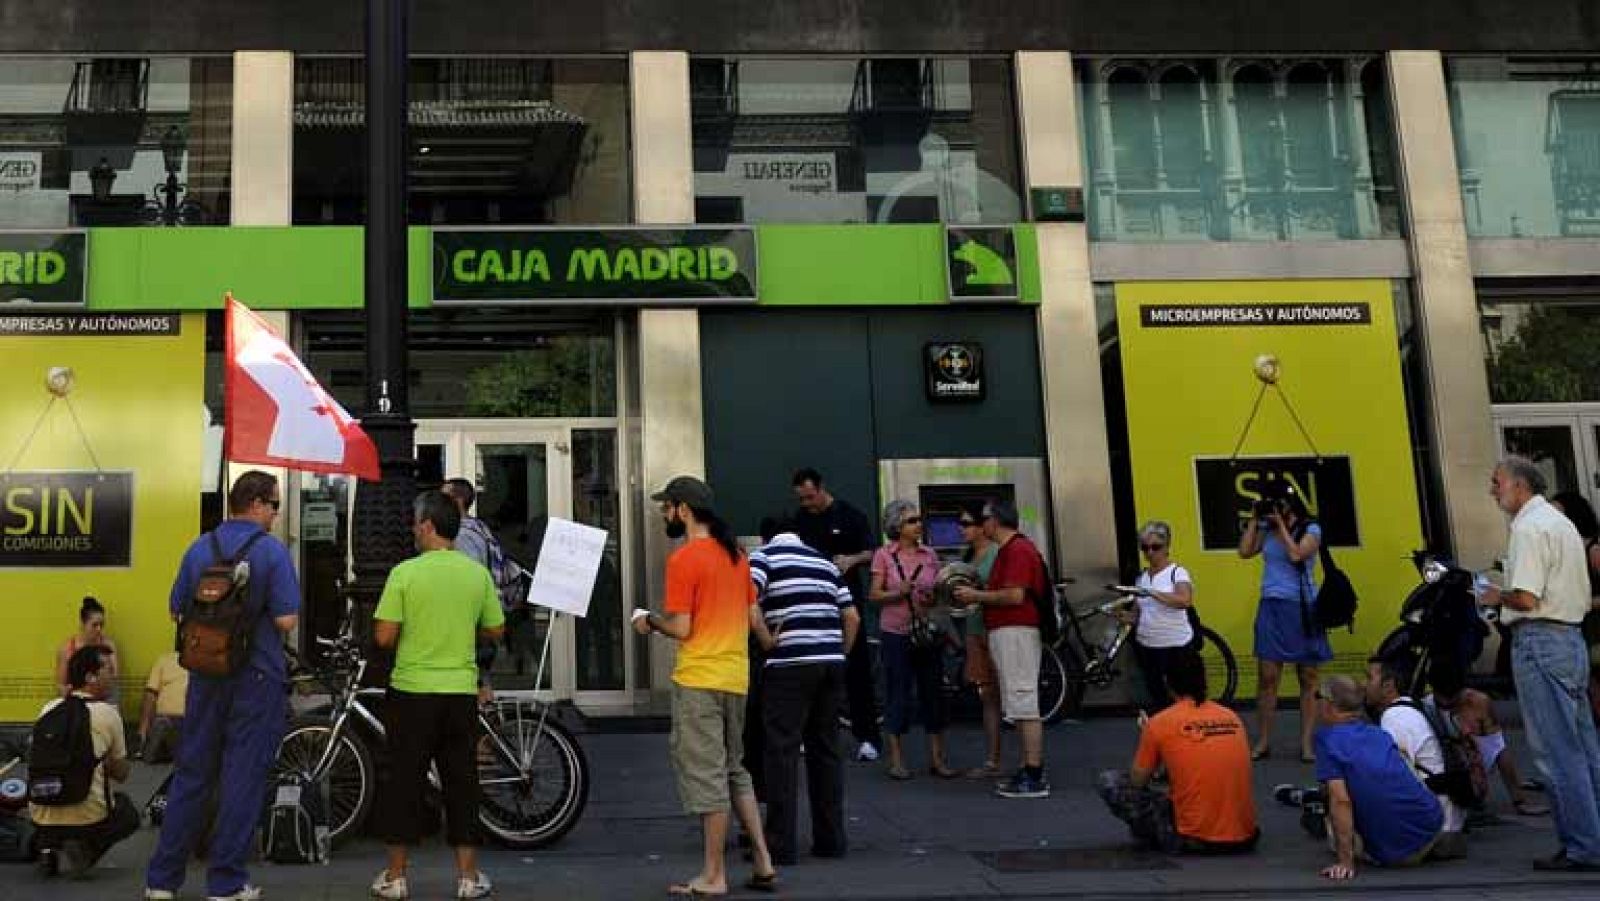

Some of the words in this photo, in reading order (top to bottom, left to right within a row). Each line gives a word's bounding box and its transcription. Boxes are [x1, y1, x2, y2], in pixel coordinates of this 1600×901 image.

[453, 249, 551, 281] CAJA
[567, 247, 738, 281] MADRID
[69, 316, 76, 331] Y
[79, 313, 170, 331] AUTÓNOMOS
[1151, 307, 1263, 323] MICROEMPRESAS
[1266, 307, 1274, 321] Y
[1277, 304, 1361, 321] AUTÓNOMOS
[4, 487, 93, 535] SIN
[1235, 470, 1319, 518] SN
